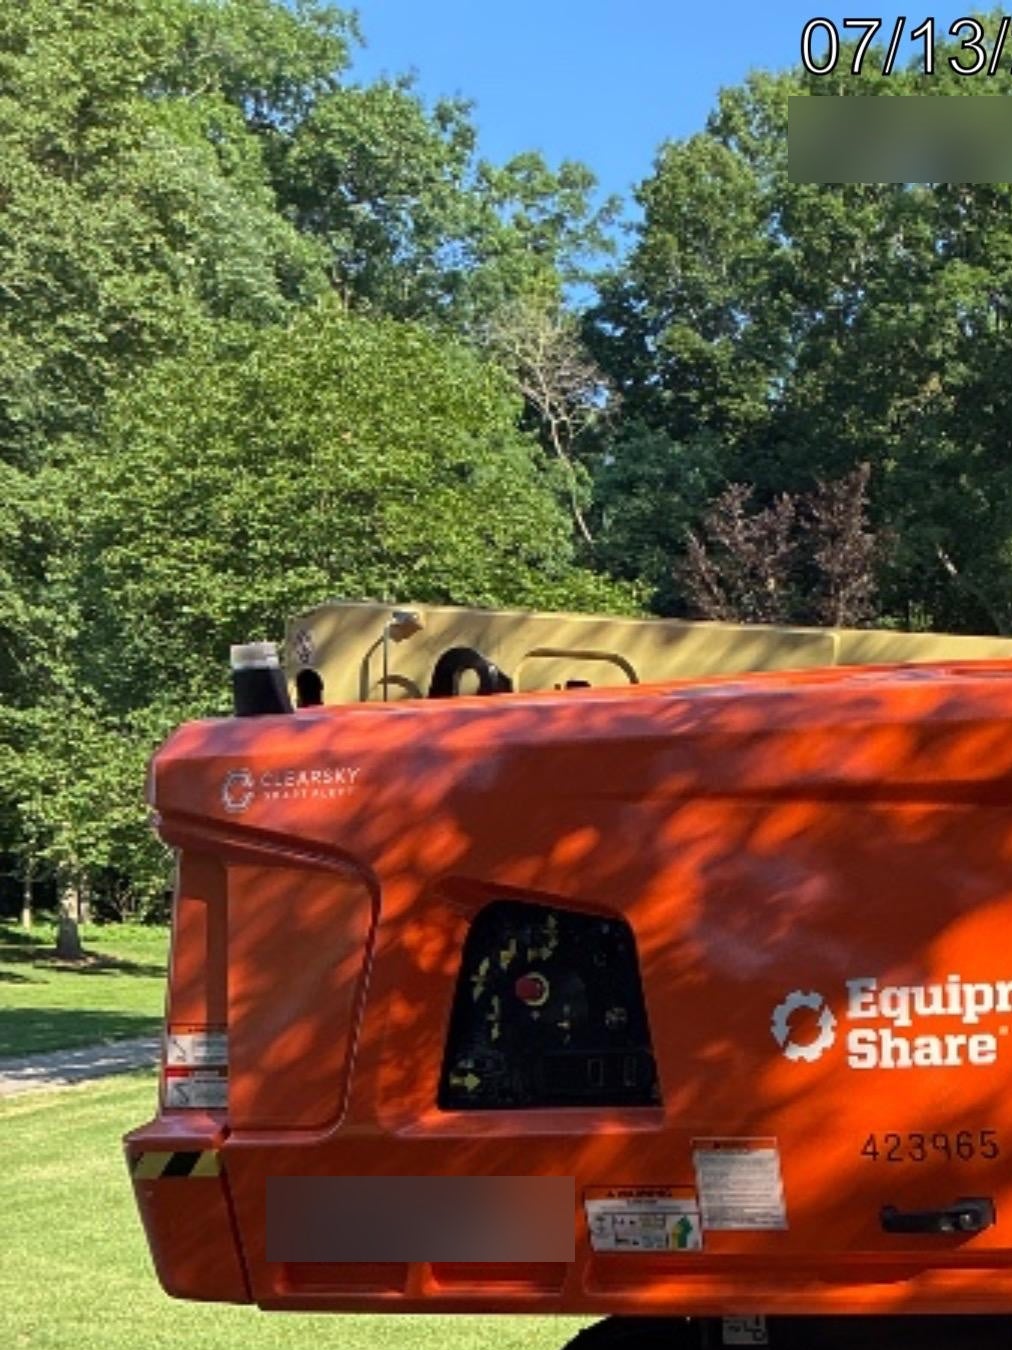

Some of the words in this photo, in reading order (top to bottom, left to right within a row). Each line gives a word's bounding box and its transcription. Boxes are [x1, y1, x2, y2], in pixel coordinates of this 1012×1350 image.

[260, 767, 360, 787] CLEARSKY
[847, 1028, 998, 1069] Share
[860, 1130, 1000, 1162] 423965
